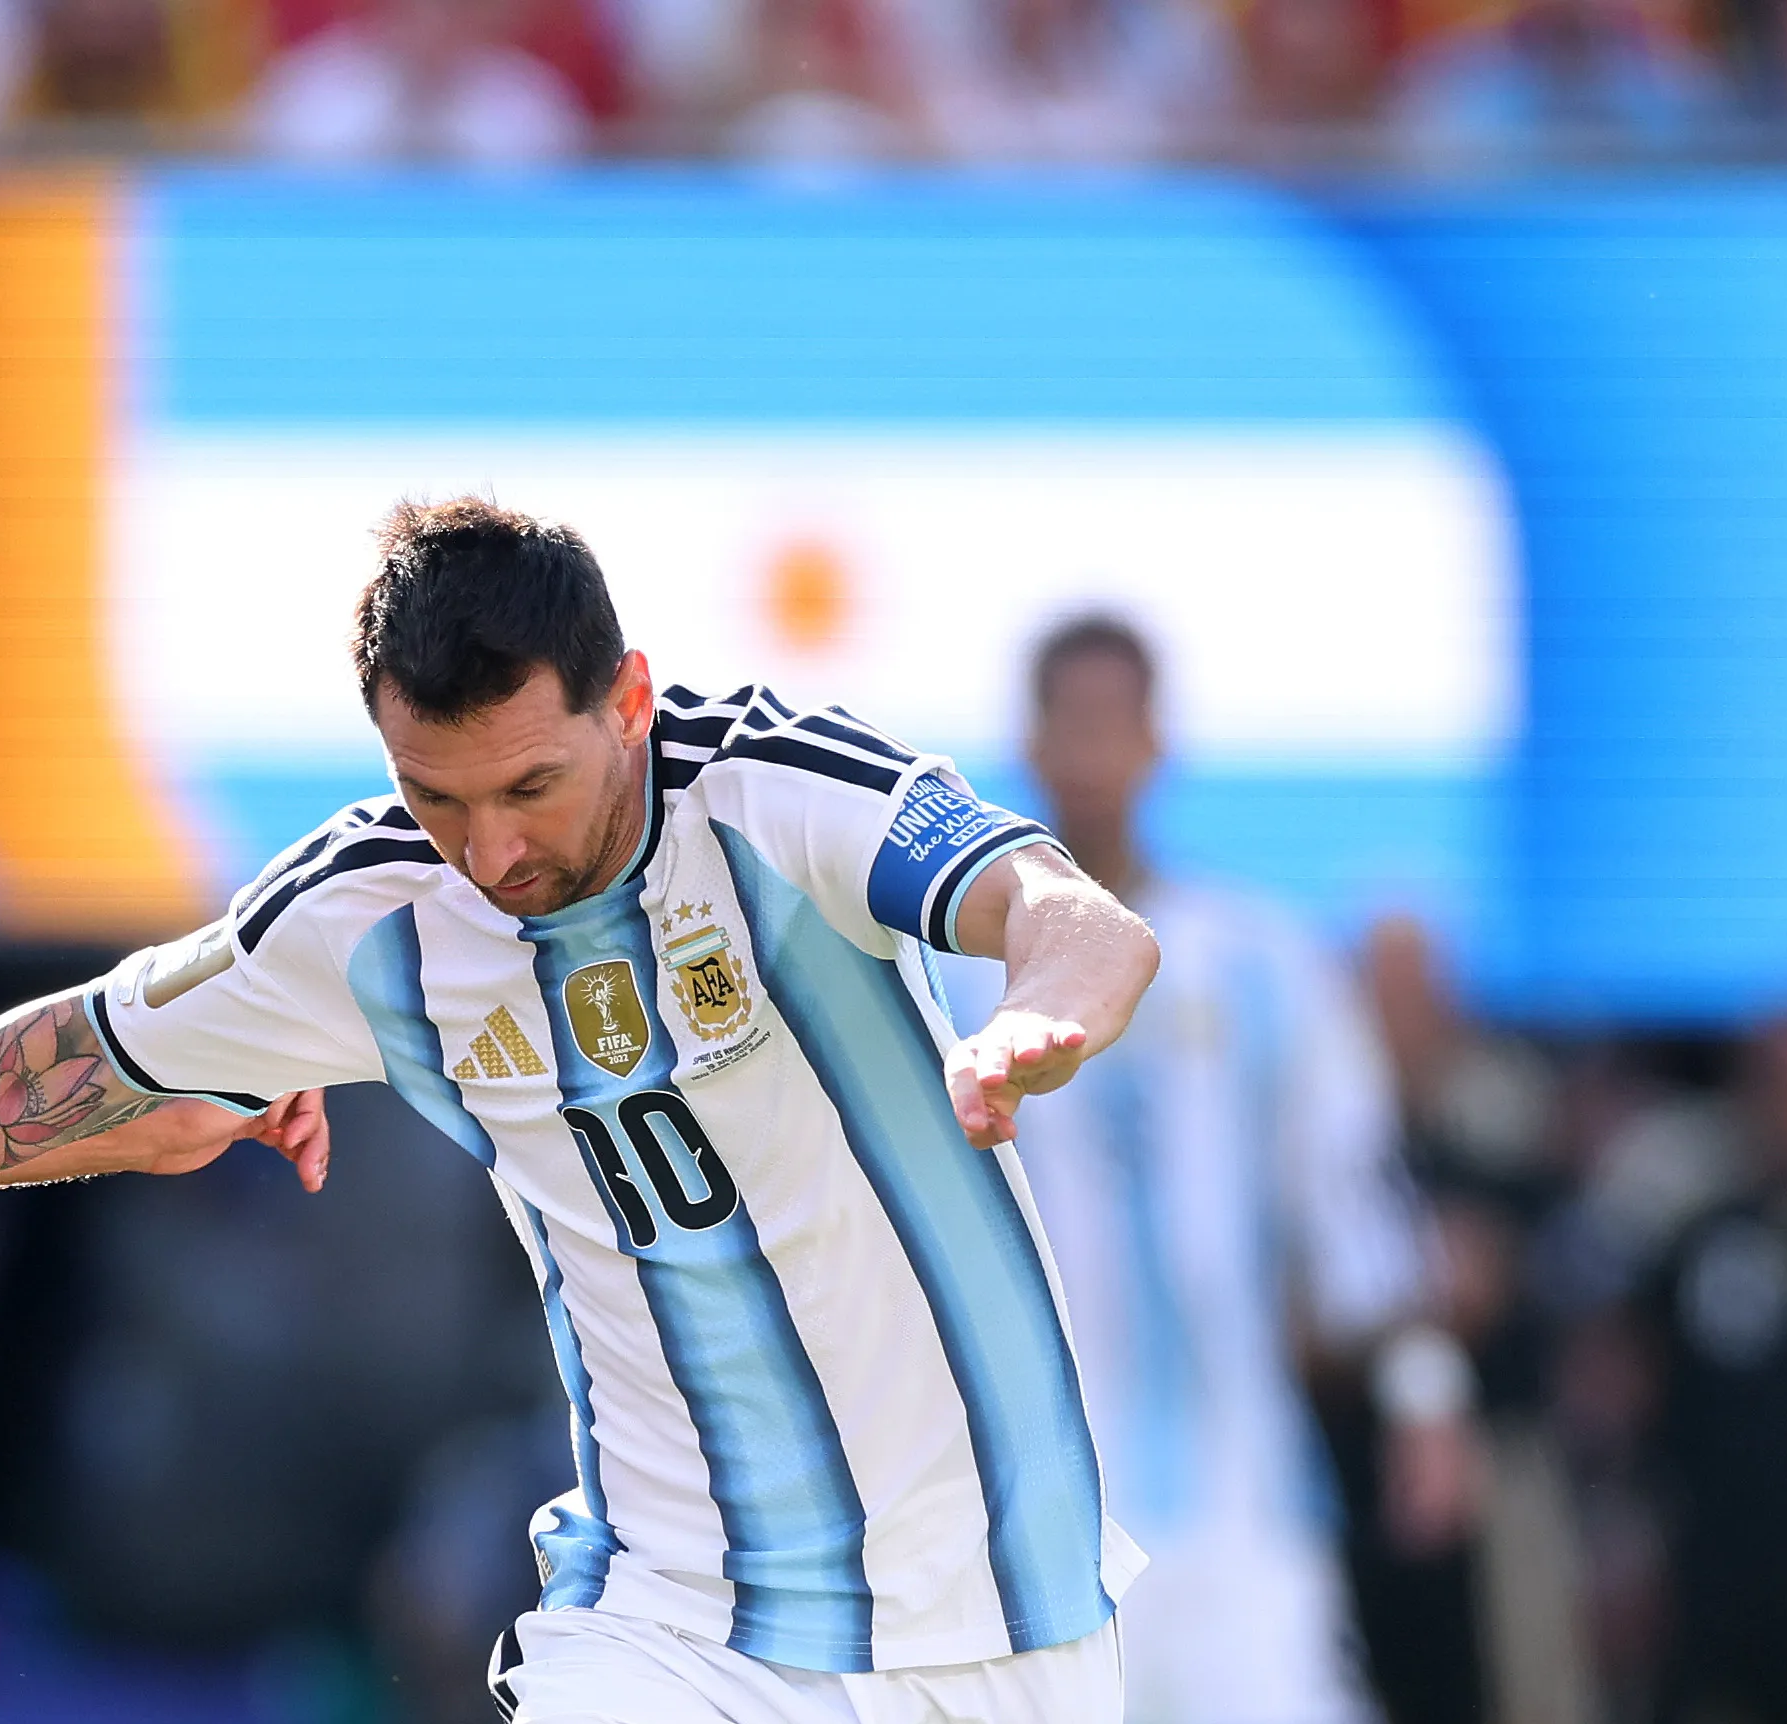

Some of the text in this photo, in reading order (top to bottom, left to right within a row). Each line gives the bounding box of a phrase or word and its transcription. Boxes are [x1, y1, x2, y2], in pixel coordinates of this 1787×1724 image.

[899, 778, 950, 810] TBALL
[886, 790, 973, 848] UNITES
[951, 819, 990, 845] FIFA
[907, 833, 943, 862] the
[686, 956, 735, 1008] AFA
[596, 1033, 632, 1052] FIFA
[608, 1053, 630, 1065] 2022
[562, 1090, 740, 1249] 10
